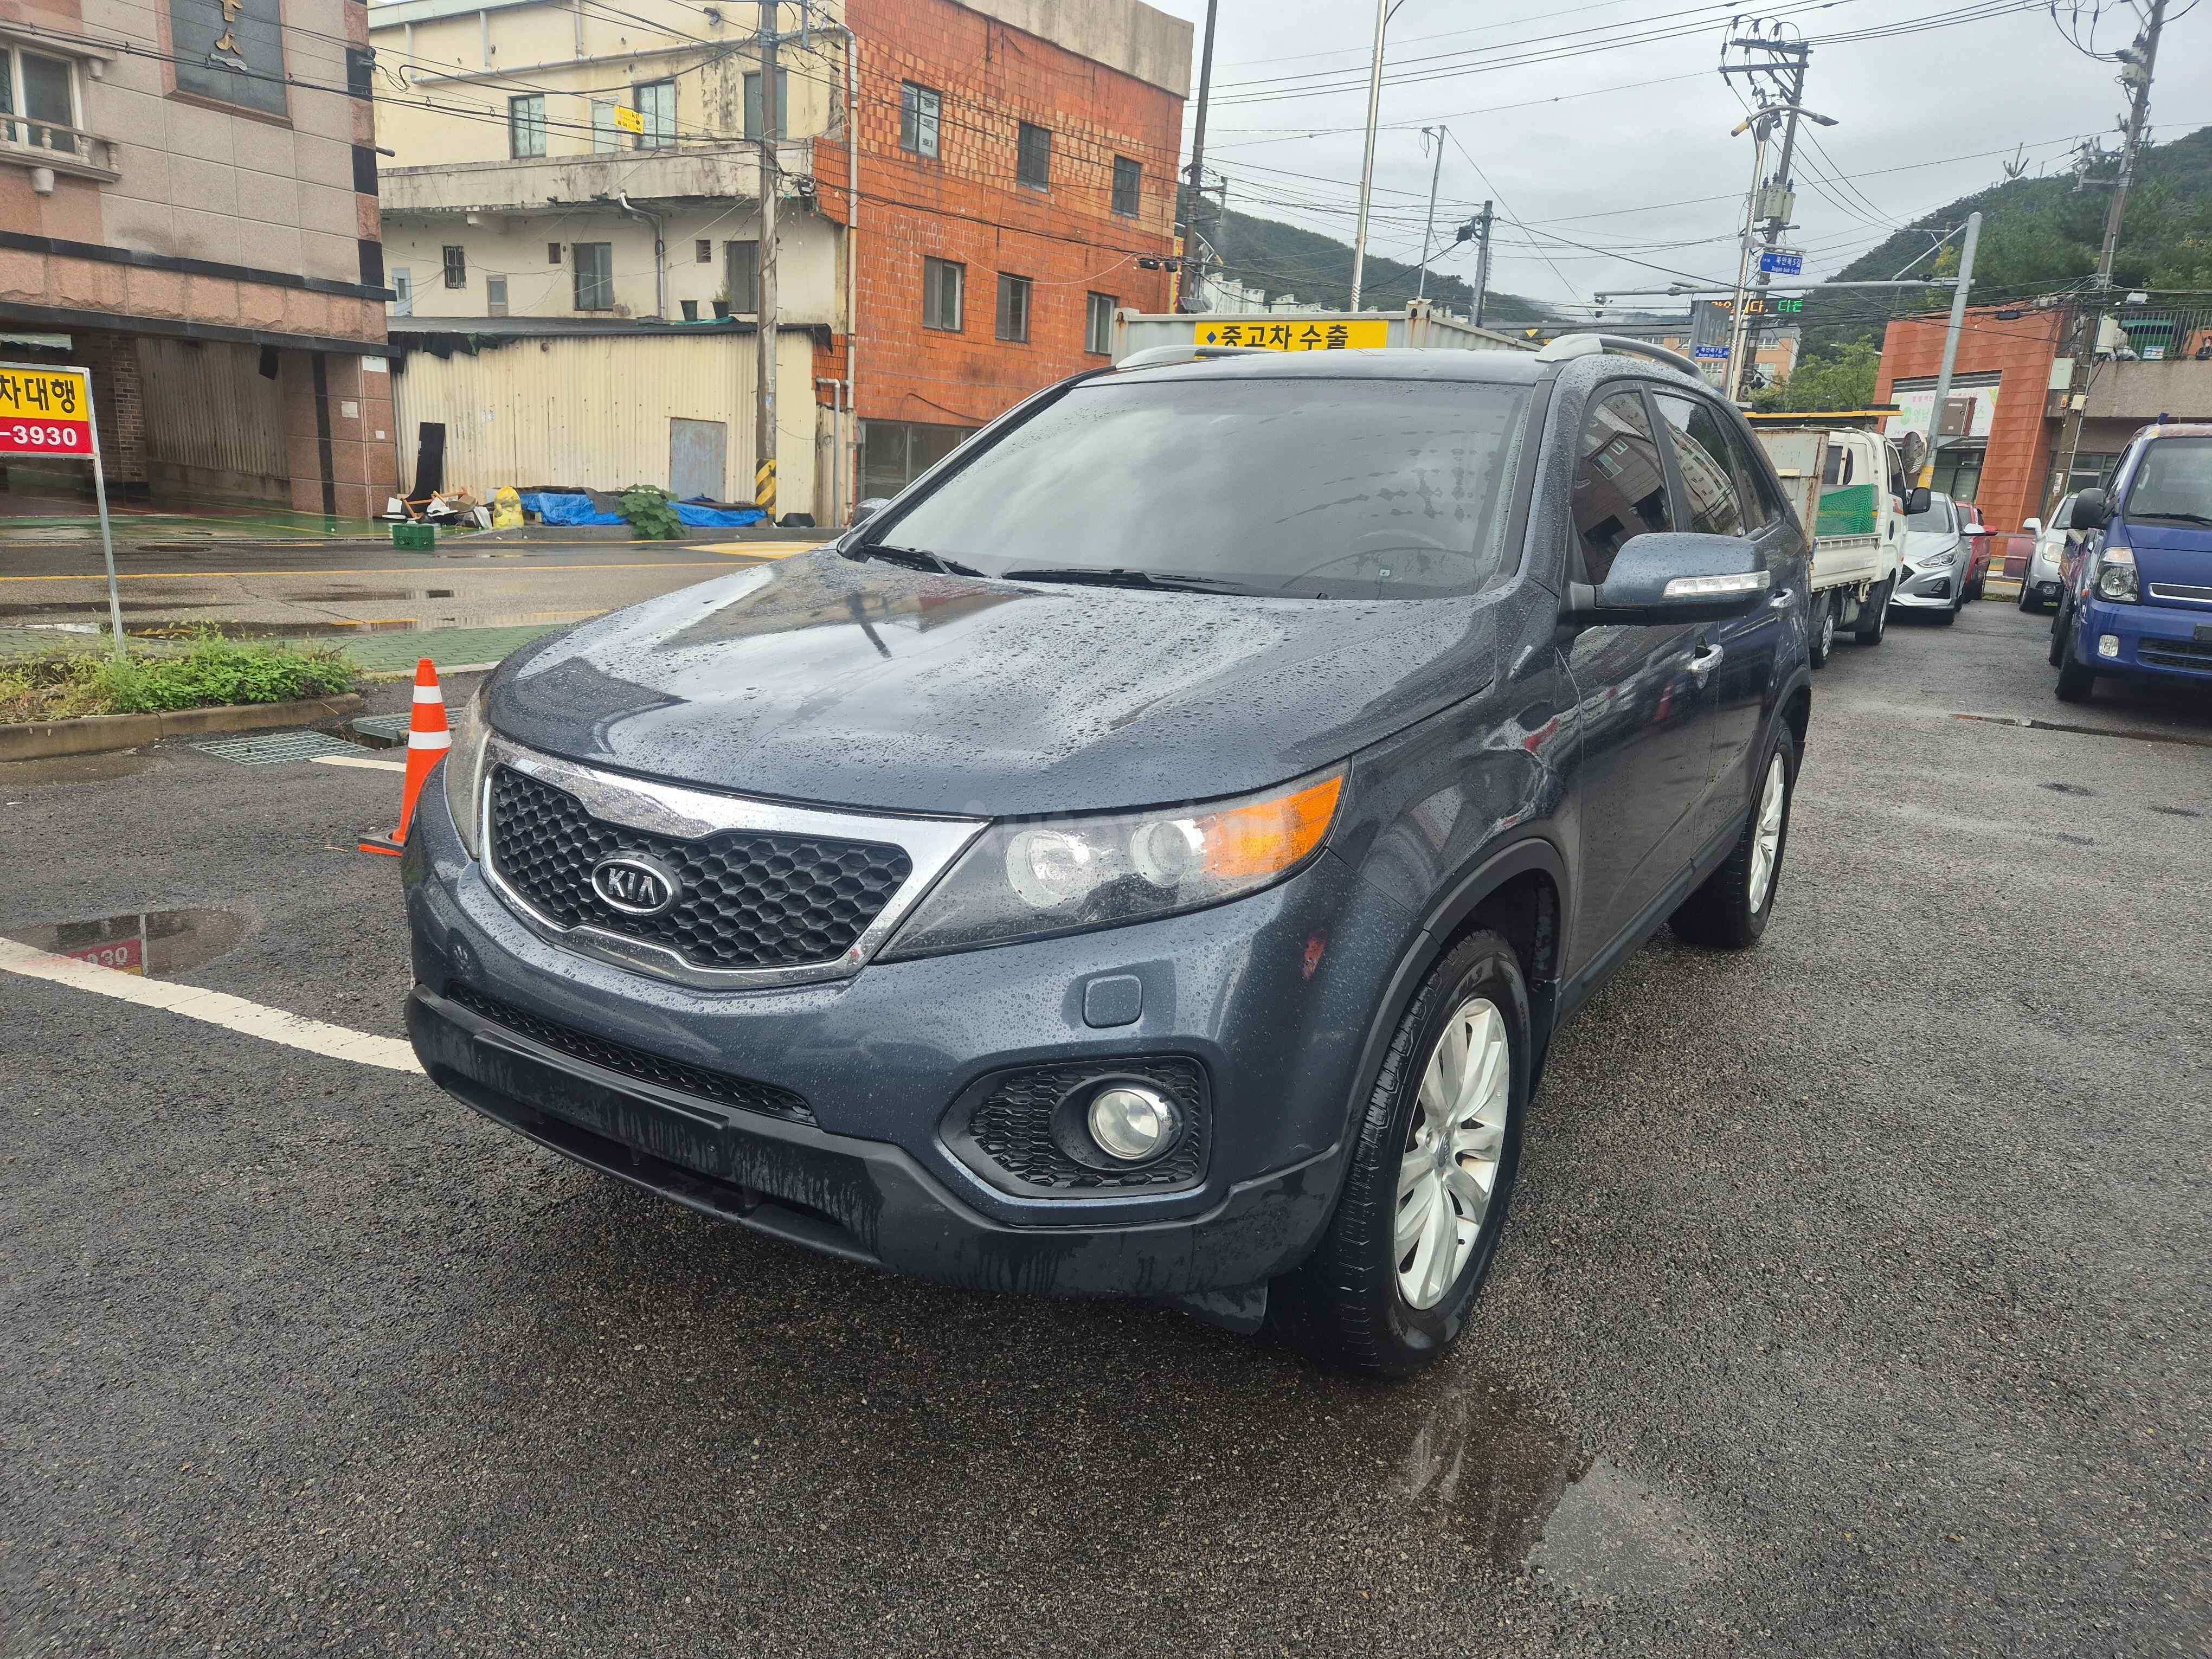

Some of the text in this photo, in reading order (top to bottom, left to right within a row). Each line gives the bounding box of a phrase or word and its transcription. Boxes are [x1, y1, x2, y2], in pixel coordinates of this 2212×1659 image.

[1221, 324, 1348, 350] 중고차 수출
[0, 375, 75, 413] 차대행
[608, 868, 655, 905] KIA
